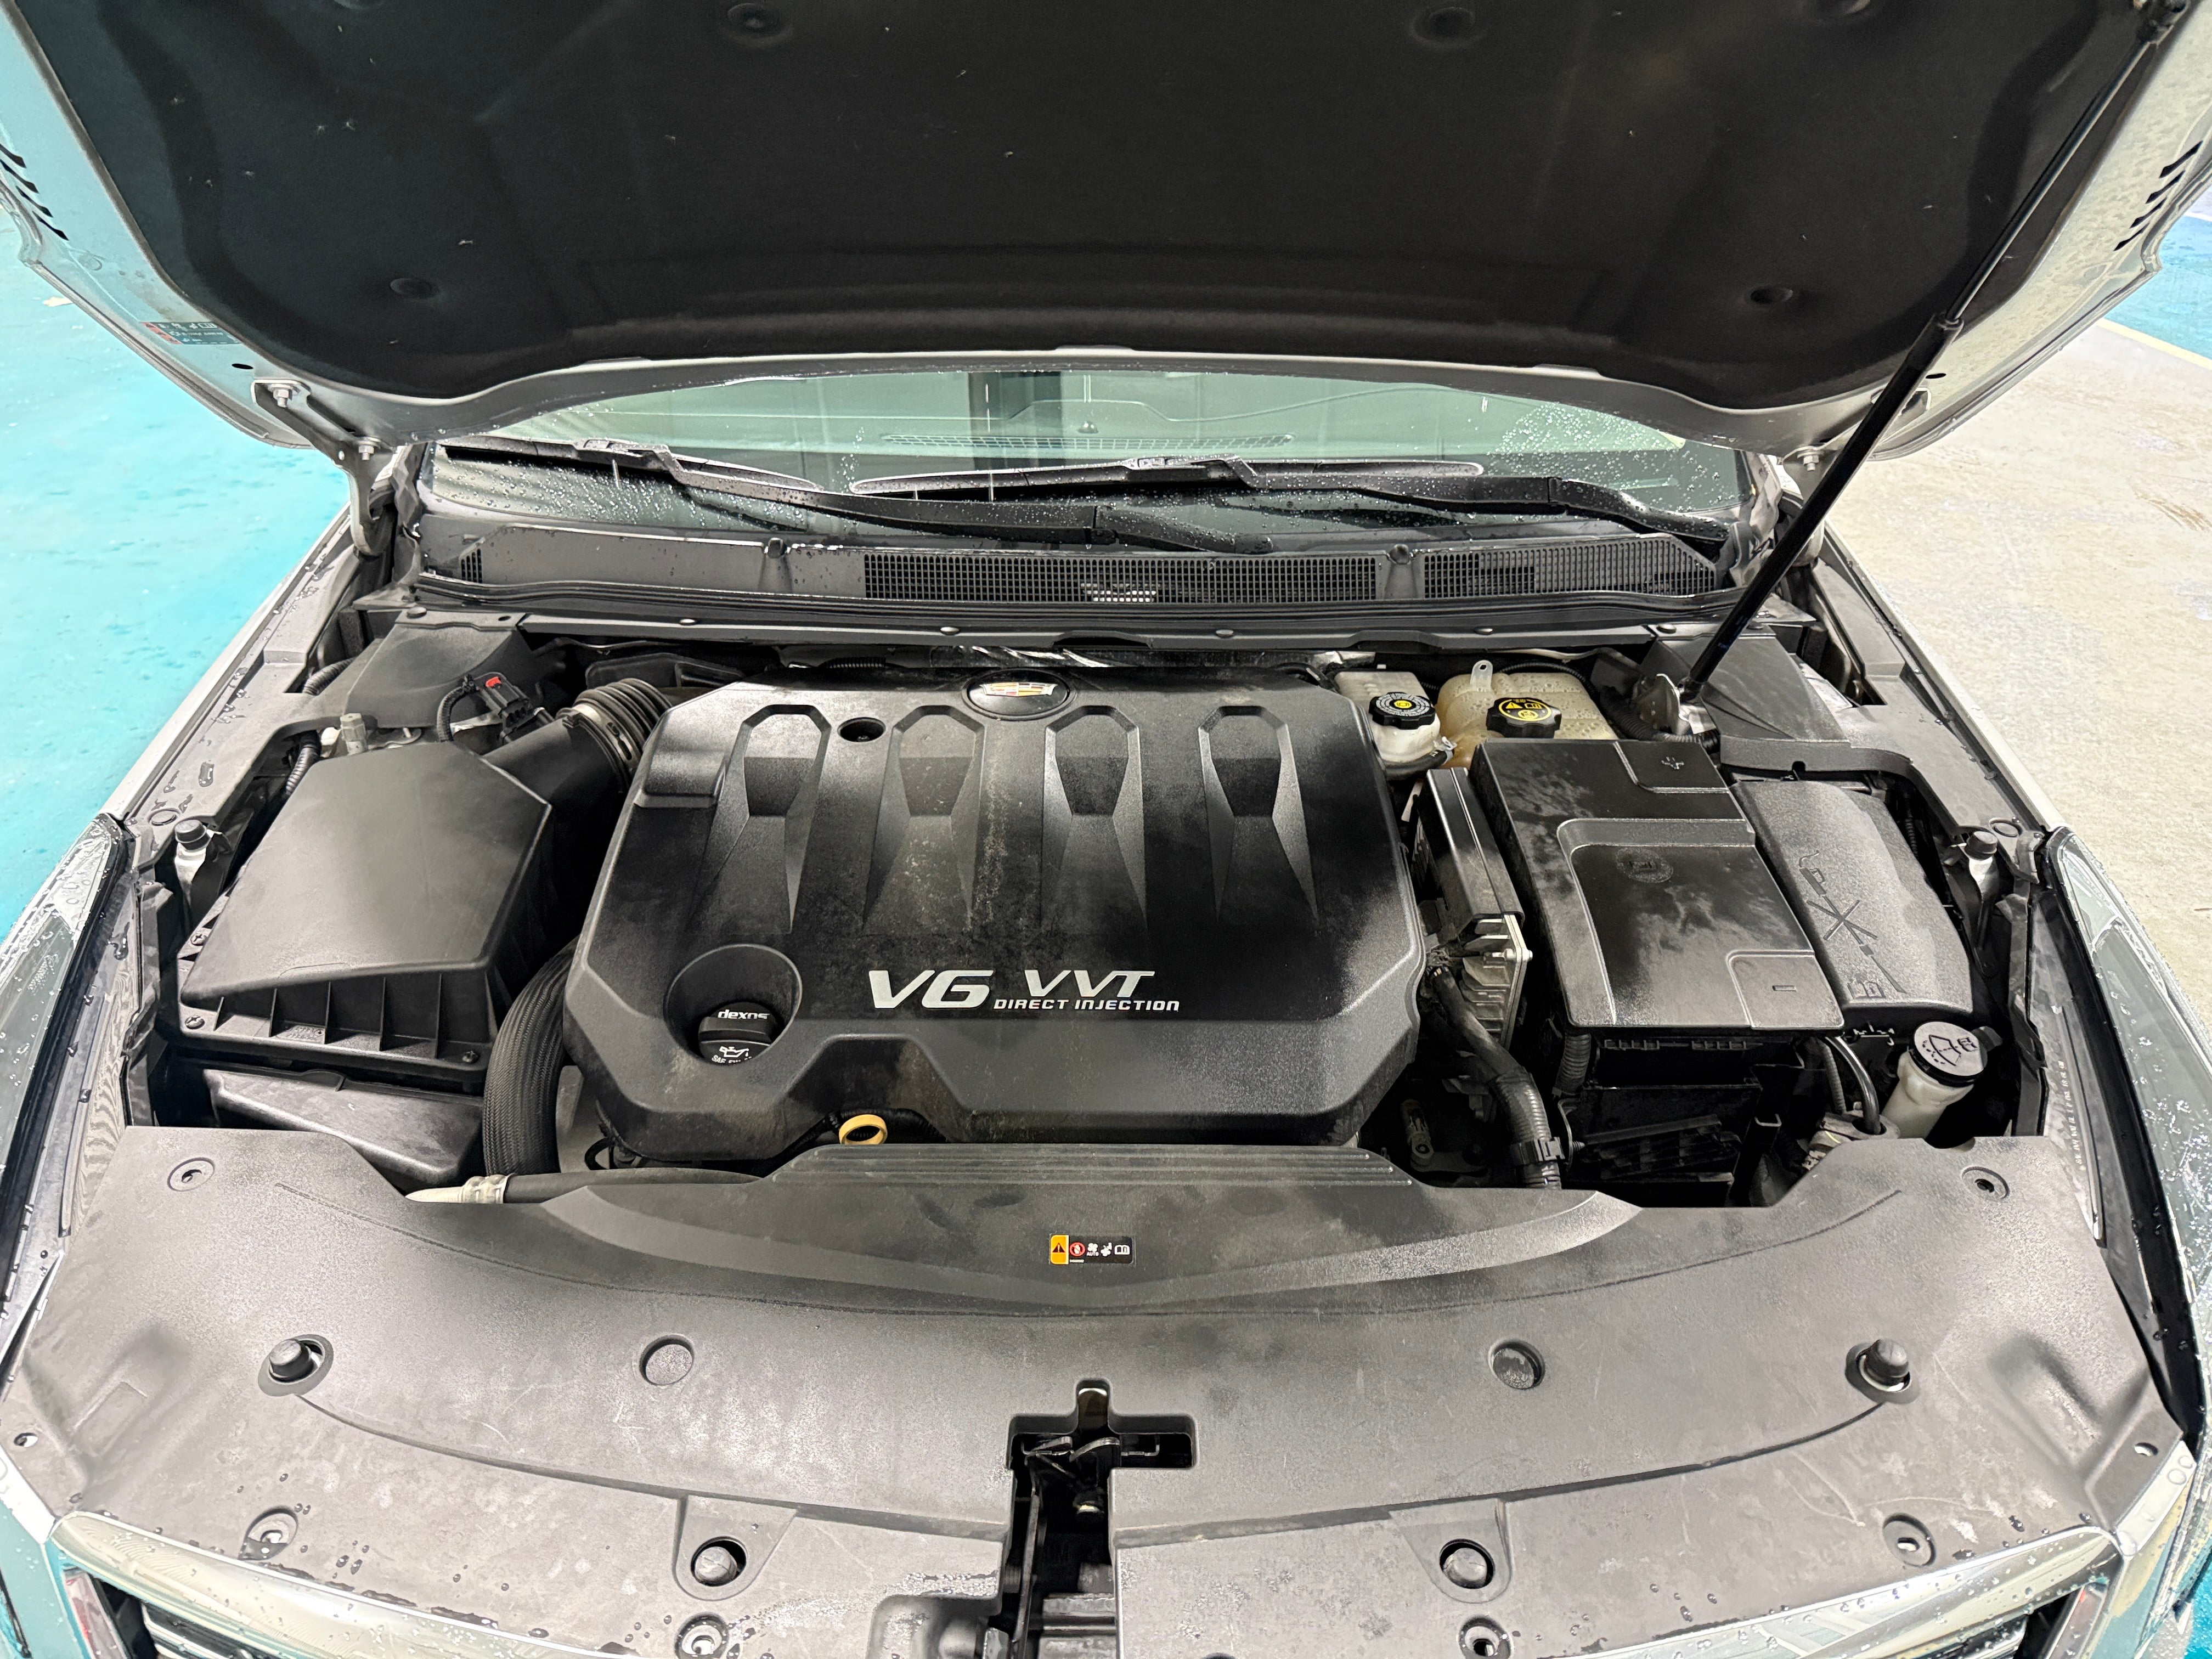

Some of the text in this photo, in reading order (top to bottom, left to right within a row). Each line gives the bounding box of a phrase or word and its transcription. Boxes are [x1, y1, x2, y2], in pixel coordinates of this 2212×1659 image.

[868, 969, 1155, 1009] V6 VVT
[993, 998, 1180, 1012] DIRECT INJECTION
